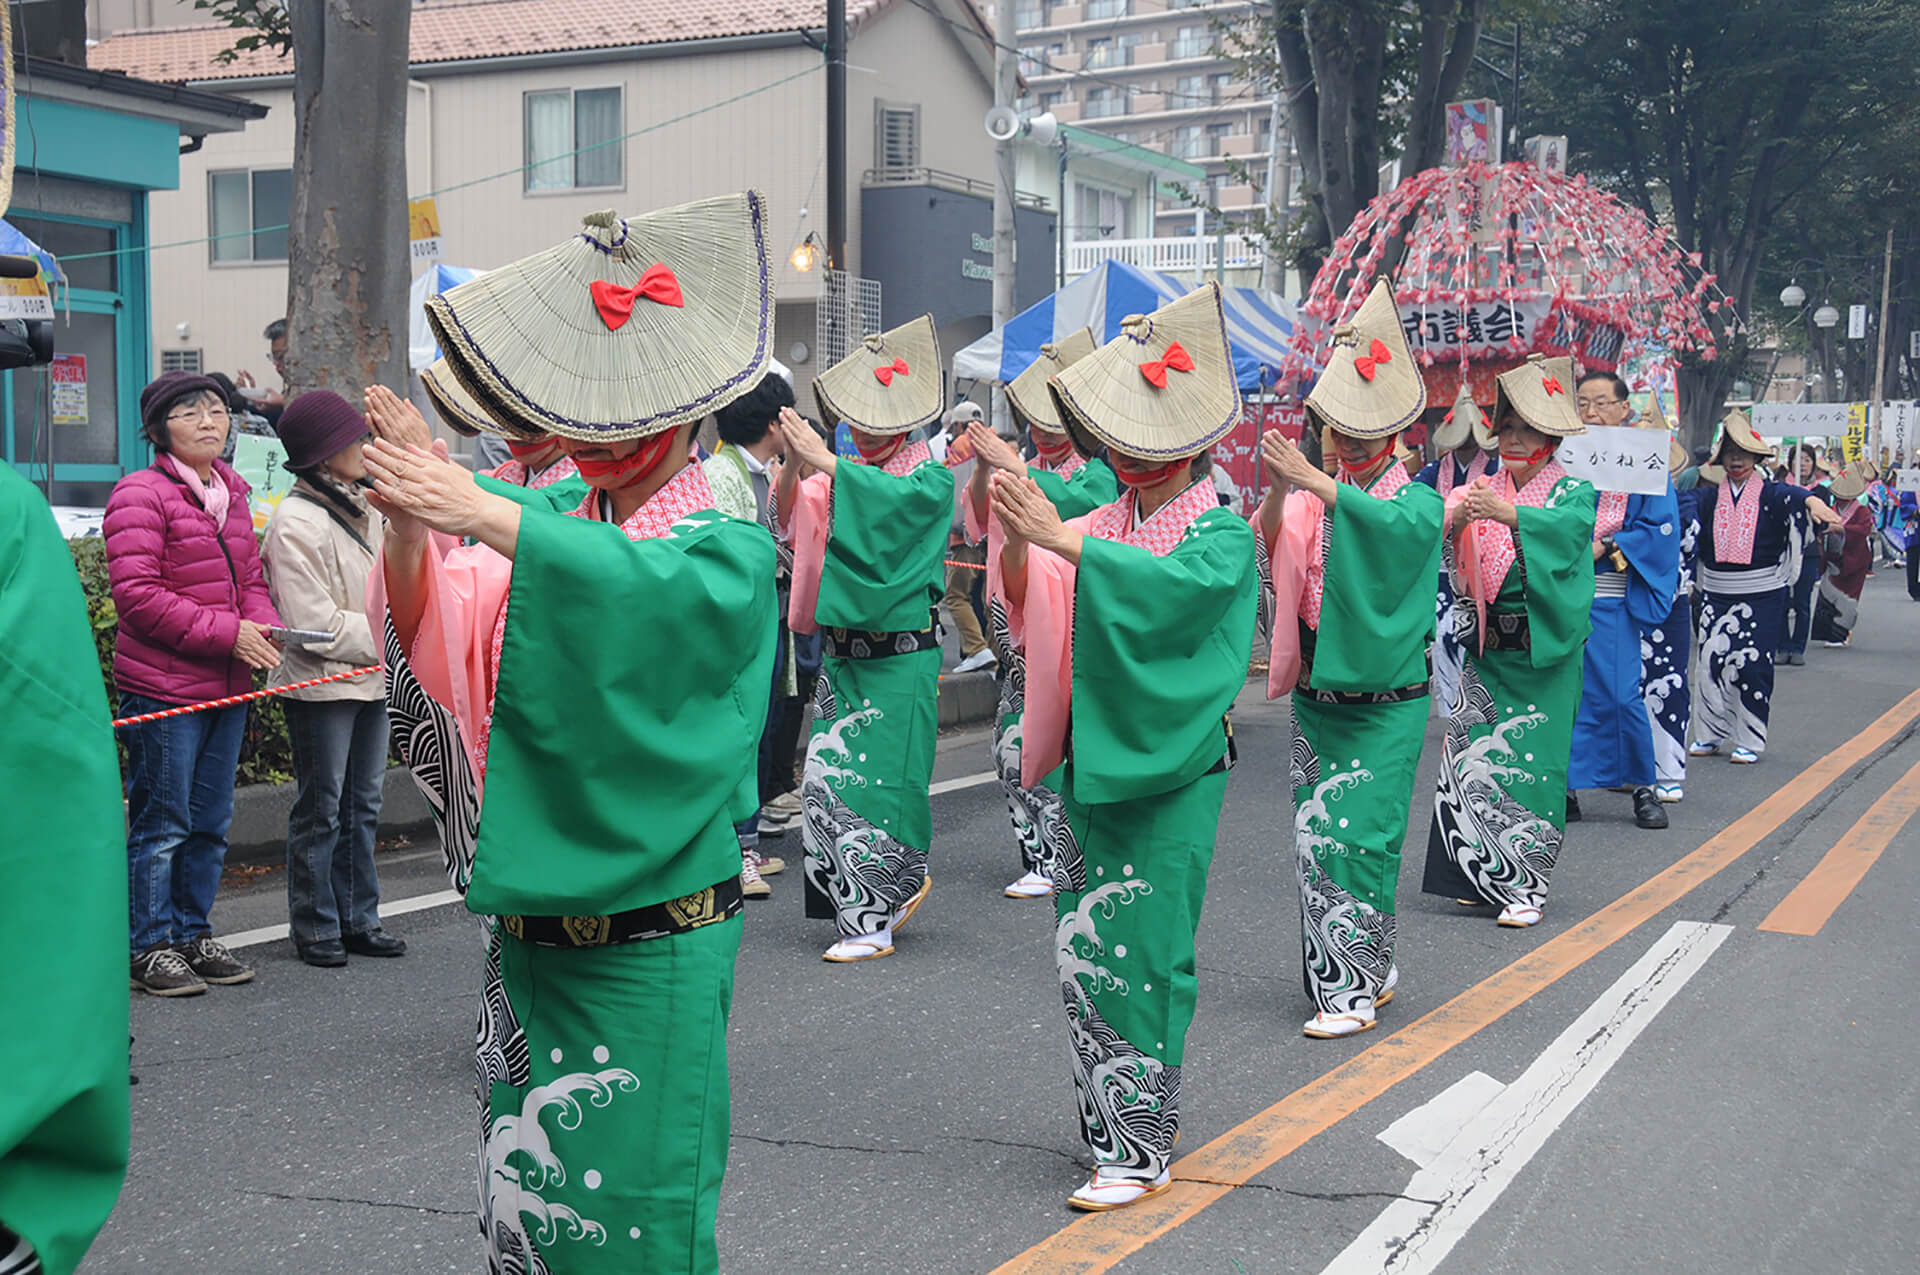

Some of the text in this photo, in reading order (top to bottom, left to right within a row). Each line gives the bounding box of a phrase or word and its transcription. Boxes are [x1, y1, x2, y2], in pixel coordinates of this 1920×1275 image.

[1402, 304, 1525, 347] 市議会
[260, 450, 279, 491] 生ビール
[1561, 449, 1665, 471] こがね会
